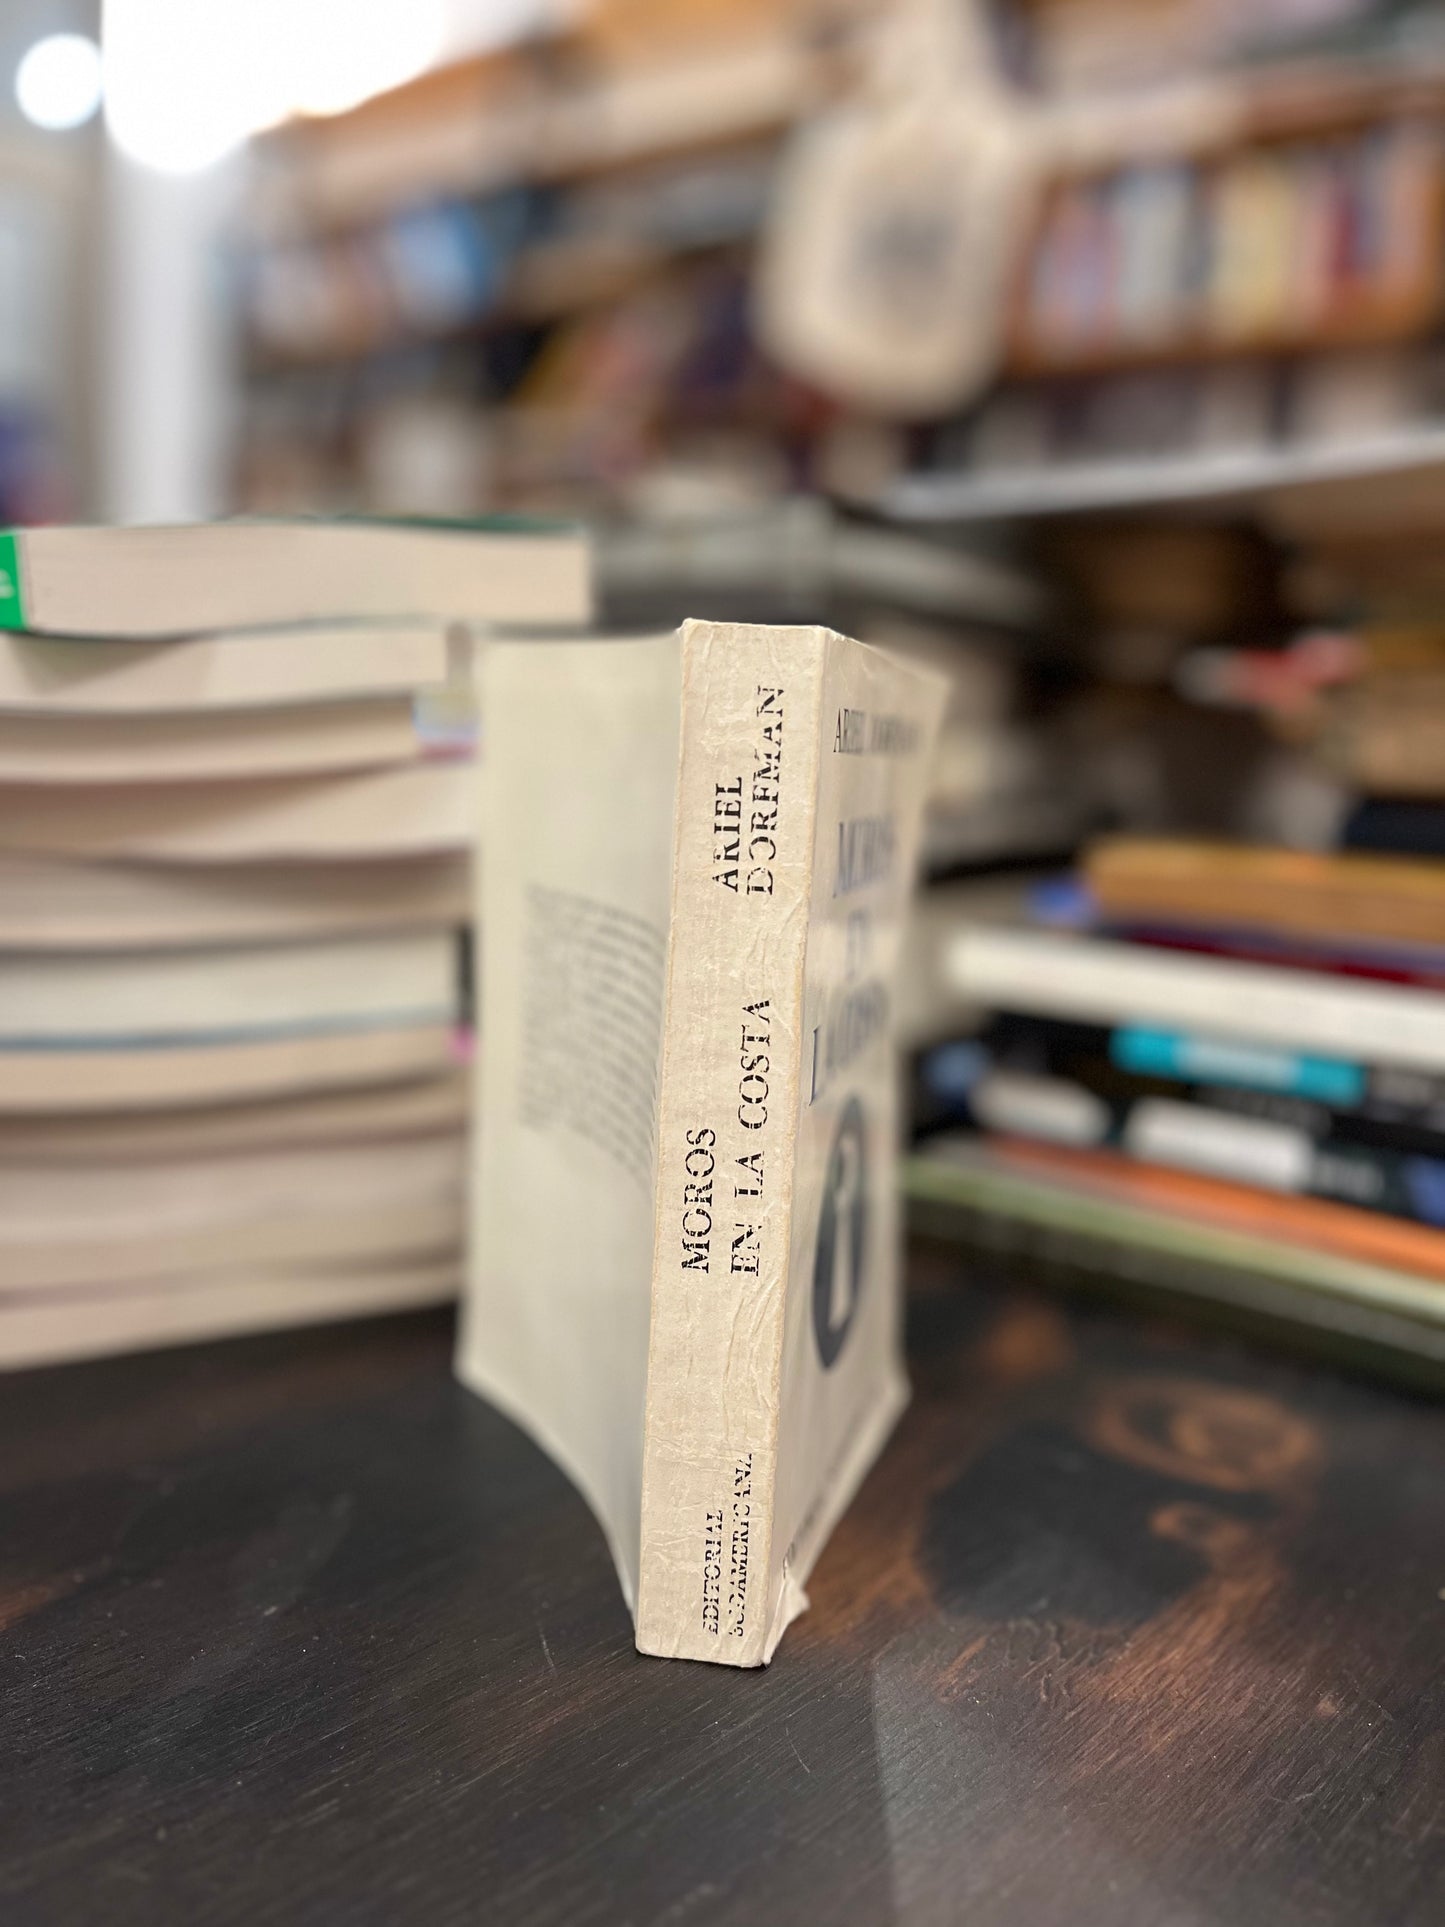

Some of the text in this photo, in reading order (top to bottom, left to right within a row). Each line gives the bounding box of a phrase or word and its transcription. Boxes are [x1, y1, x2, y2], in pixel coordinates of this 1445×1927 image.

[713, 777, 742, 892] ARIEL
[747, 686, 784, 895] DORFMAN
[681, 1129, 715, 1273] MOROS
[732, 1000, 771, 1277] EN LA COSTA
[703, 1510, 724, 1635] EDITORIAL
